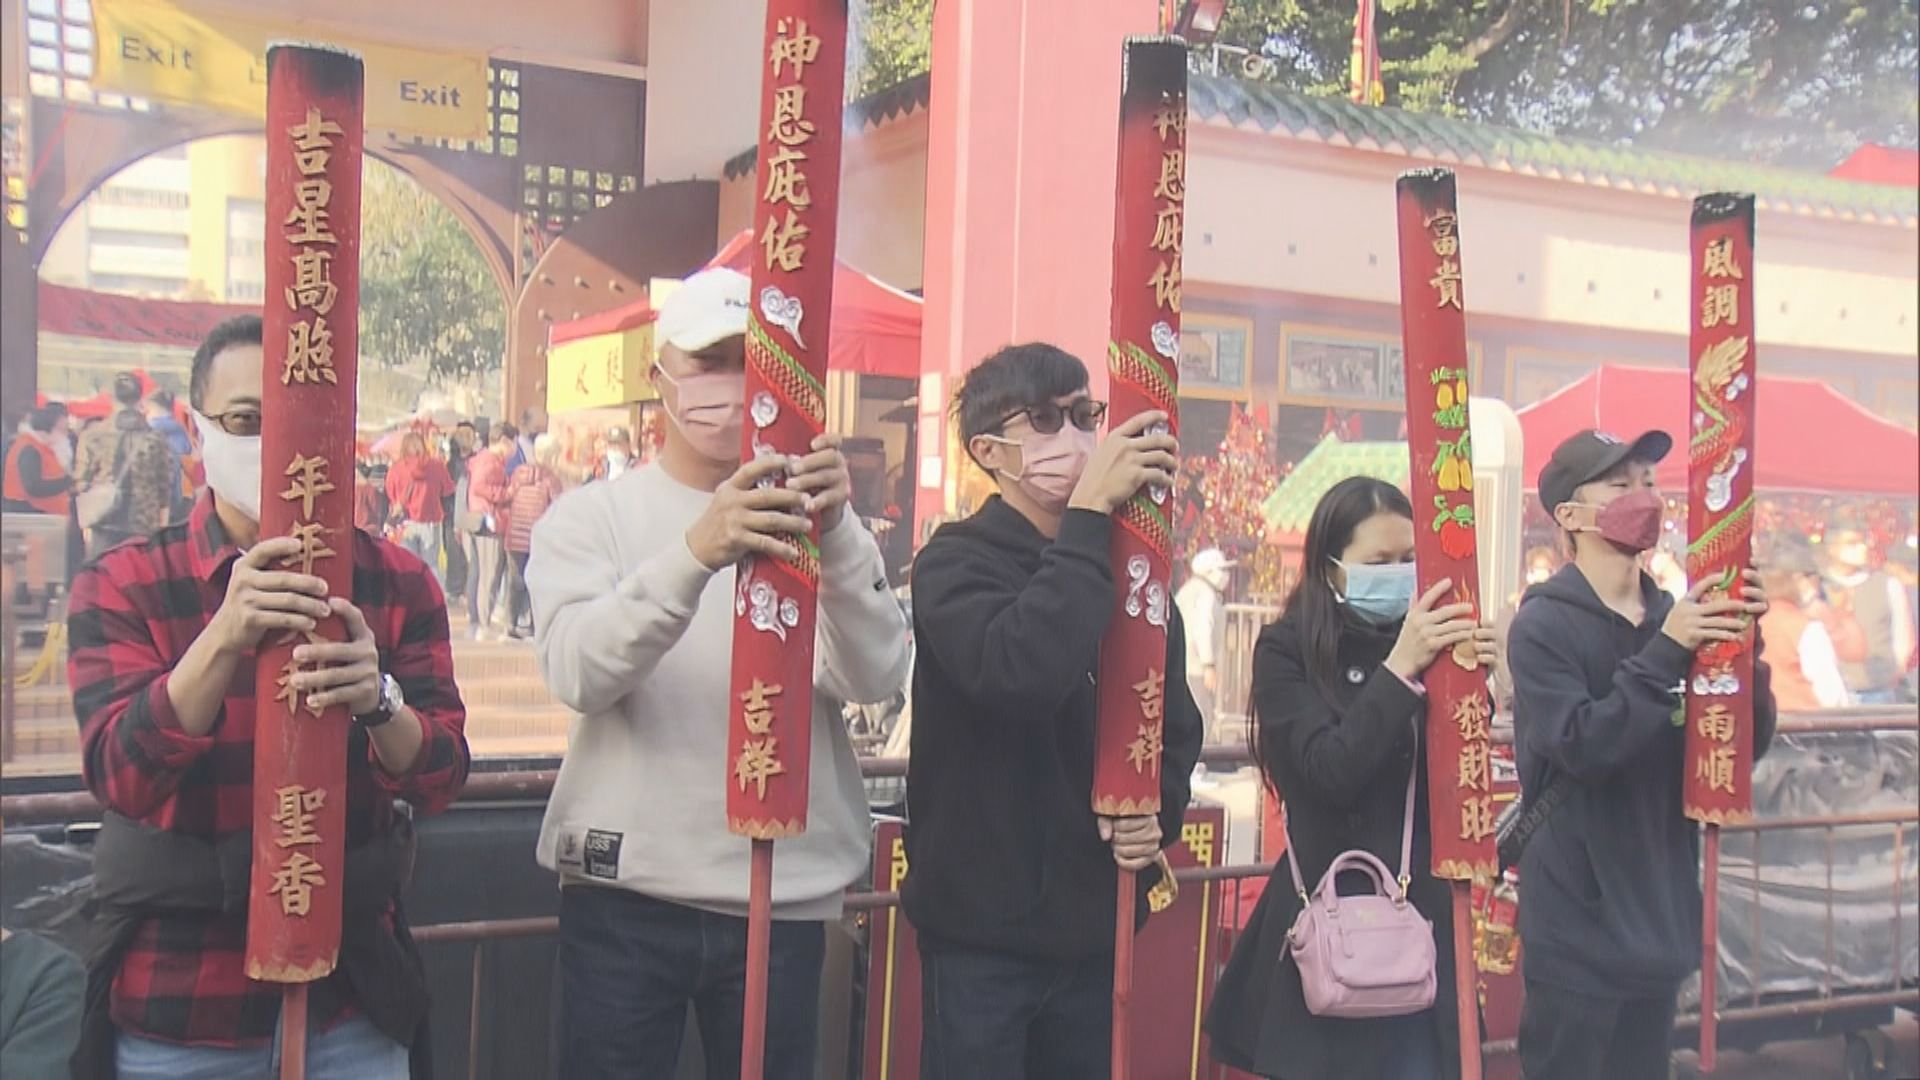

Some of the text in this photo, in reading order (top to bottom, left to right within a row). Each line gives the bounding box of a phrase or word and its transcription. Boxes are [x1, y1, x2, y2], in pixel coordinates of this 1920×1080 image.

[121, 35, 192, 70] Exit
[400, 81, 460, 108] Exit
[760, 16, 821, 273] 神恩庇佑
[1423, 208, 1461, 310] 富貴
[1701, 237, 1744, 328] 風調
[734, 676, 786, 801] 吉祥
[1126, 667, 1164, 778] 吉祥
[1451, 691, 1495, 844] 發財旺
[1696, 703, 1737, 795] 雨順
[266, 784, 327, 917] 聖香
